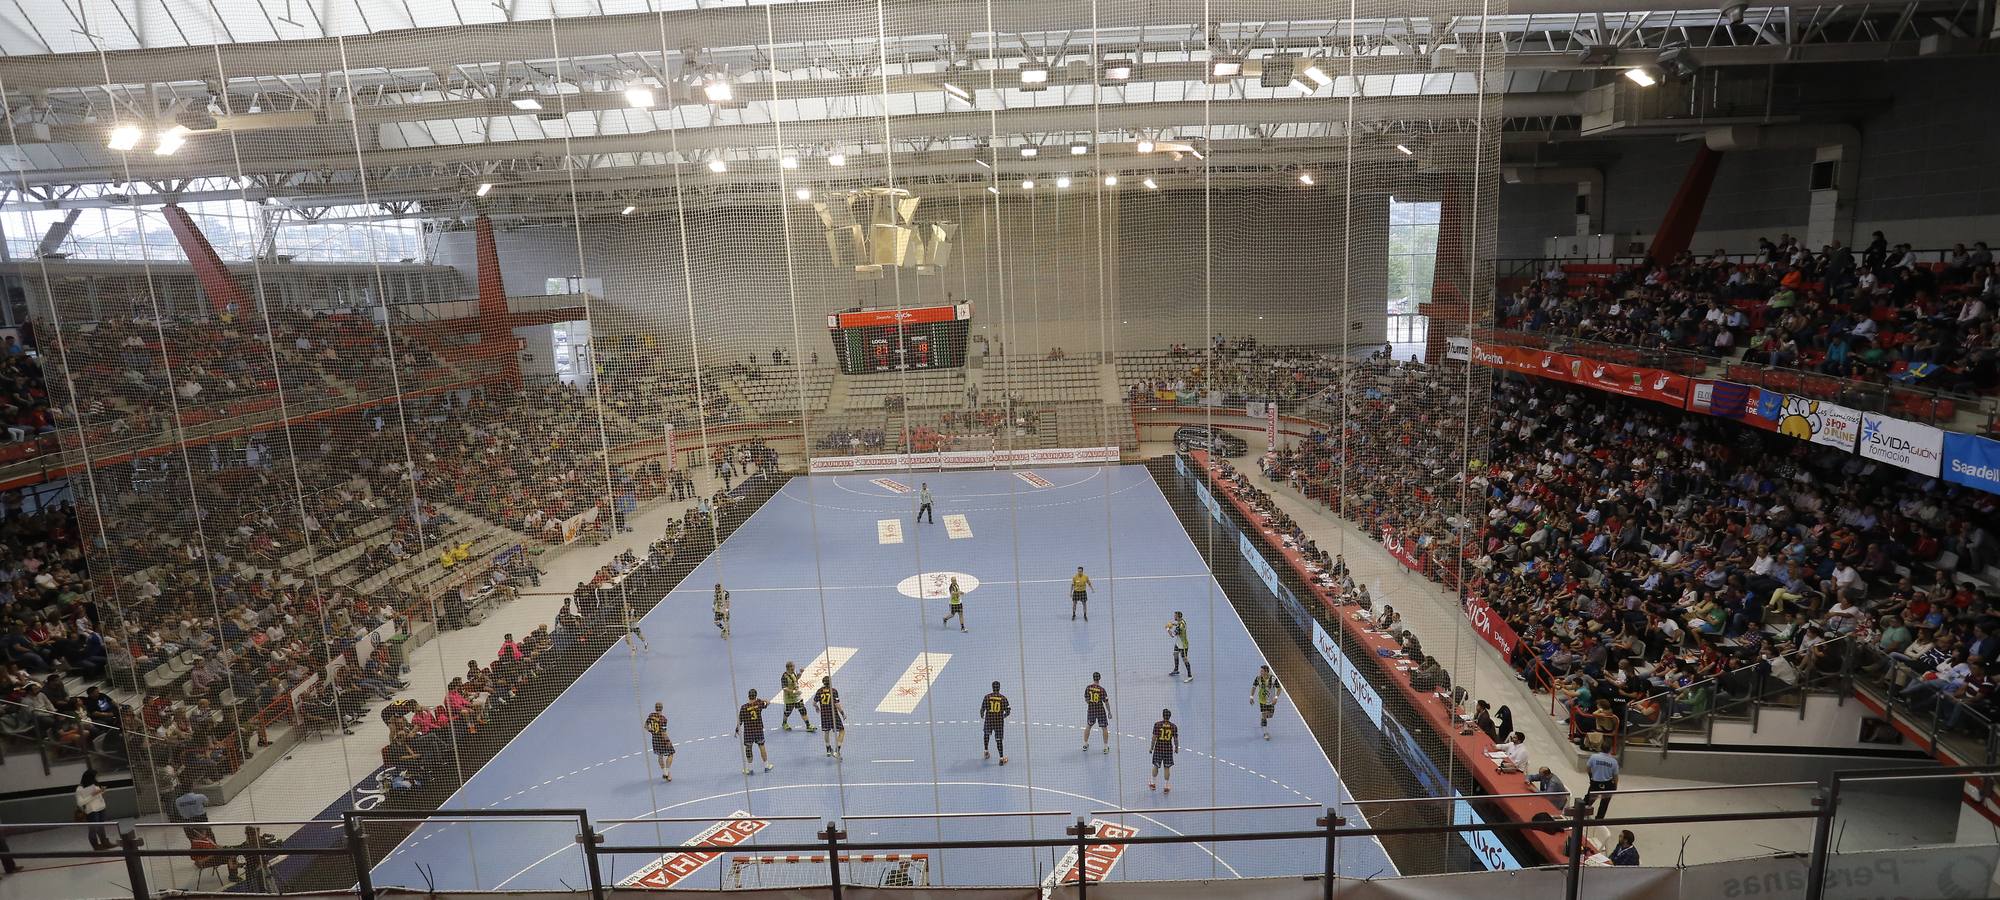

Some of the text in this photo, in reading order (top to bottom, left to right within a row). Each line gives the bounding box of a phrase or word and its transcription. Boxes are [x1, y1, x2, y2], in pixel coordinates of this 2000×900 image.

[1826, 417, 1847, 431] SHOP
[1823, 427, 1855, 443] ONLINE
[1868, 444, 1910, 465] formación
[820, 693, 831, 705] 27
[1089, 691, 1099, 703] 18
[990, 700, 1000, 713] 10
[751, 710, 757, 720] 3
[1159, 728, 1171, 741] 13
